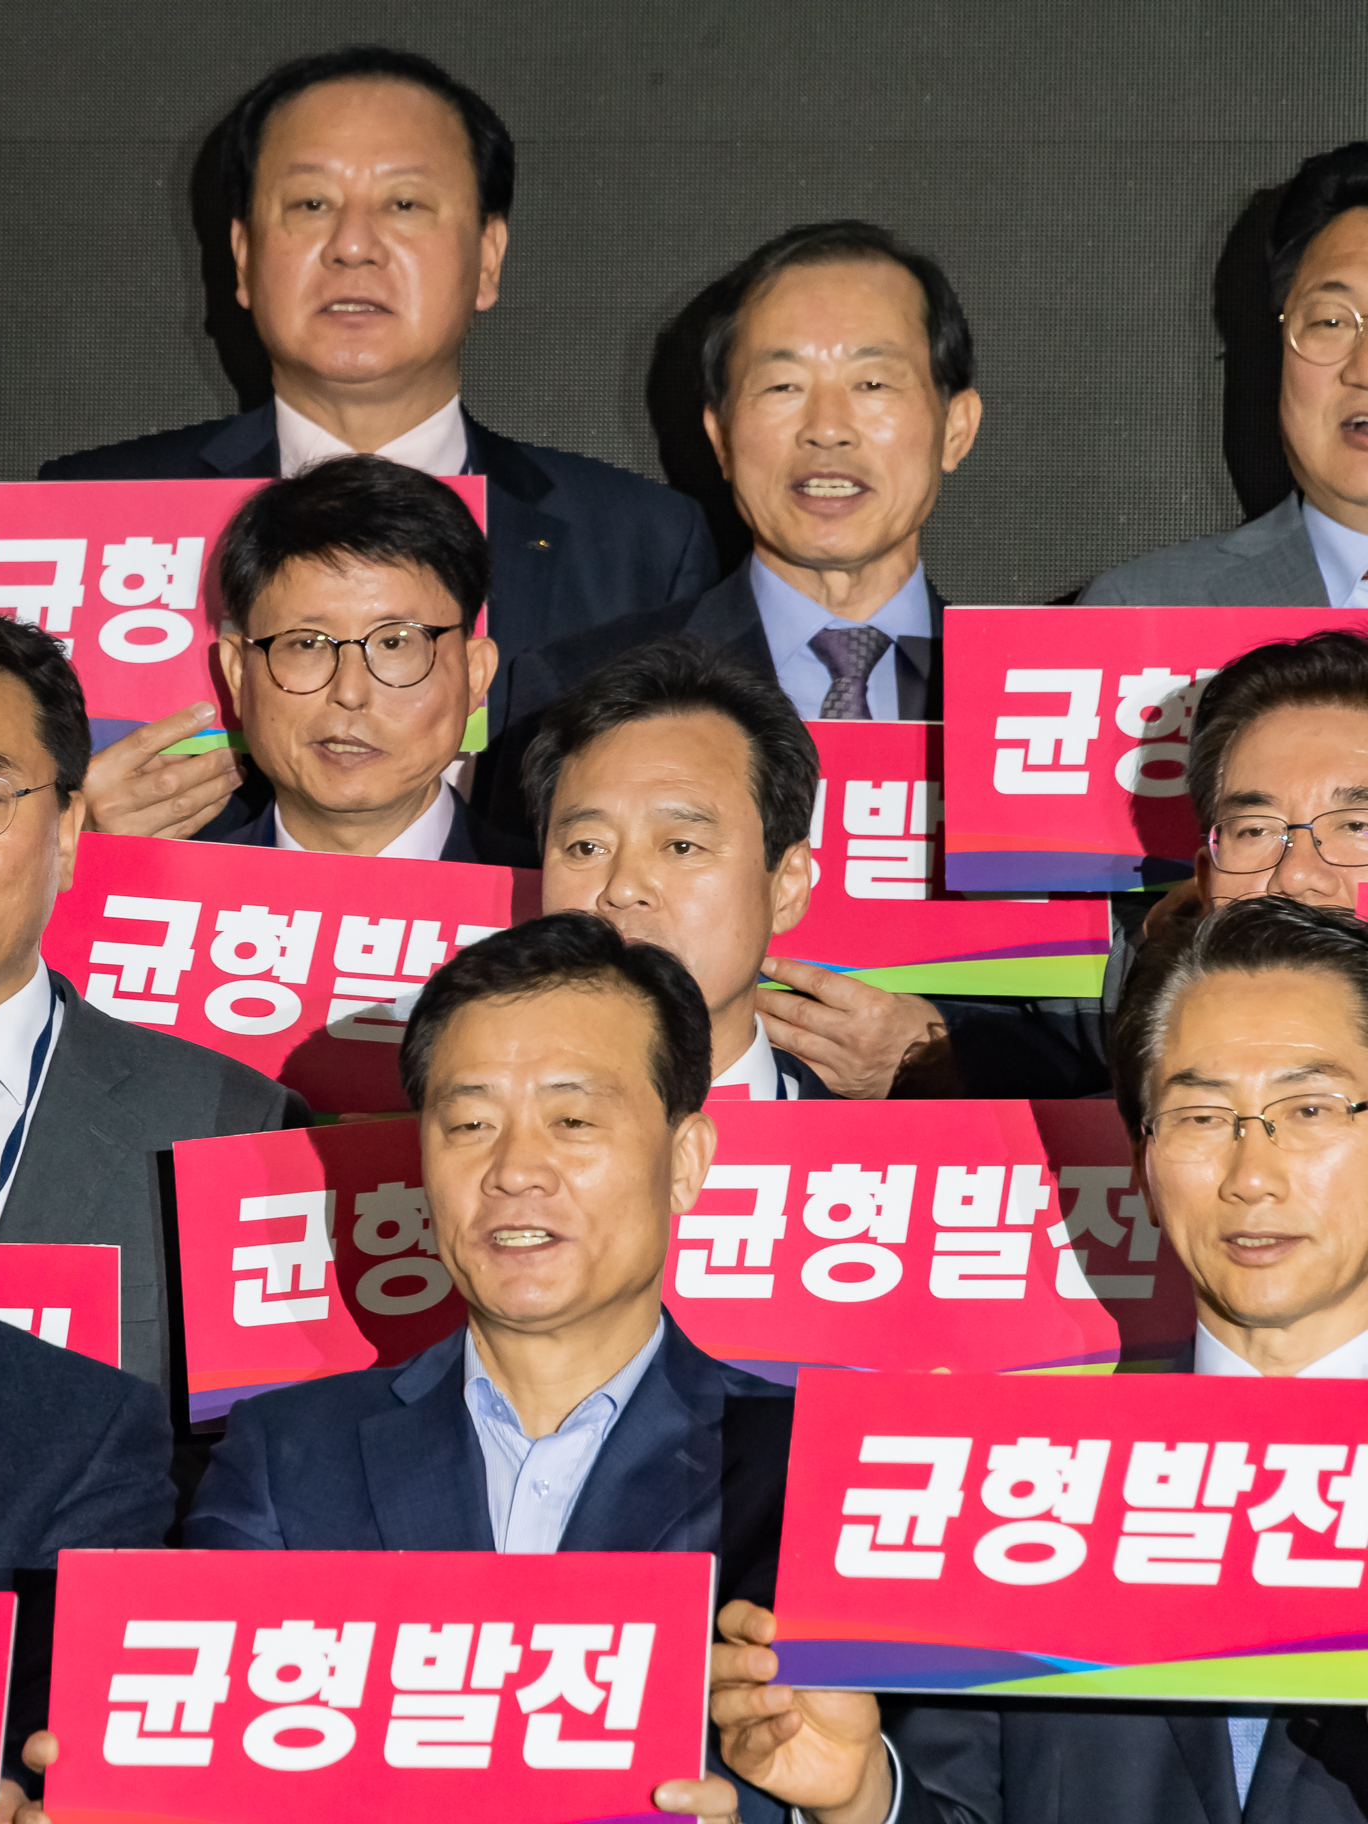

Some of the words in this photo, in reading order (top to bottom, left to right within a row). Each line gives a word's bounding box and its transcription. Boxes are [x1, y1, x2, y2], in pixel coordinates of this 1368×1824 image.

[993, 667, 1220, 798] 균형
[84, 895, 508, 1044] 균형발
[232, 1181, 454, 1327] 균형
[675, 1163, 1161, 1302] 균형발전
[835, 1435, 1368, 1588] 균형발전
[103, 1620, 655, 1771] 균형발전
